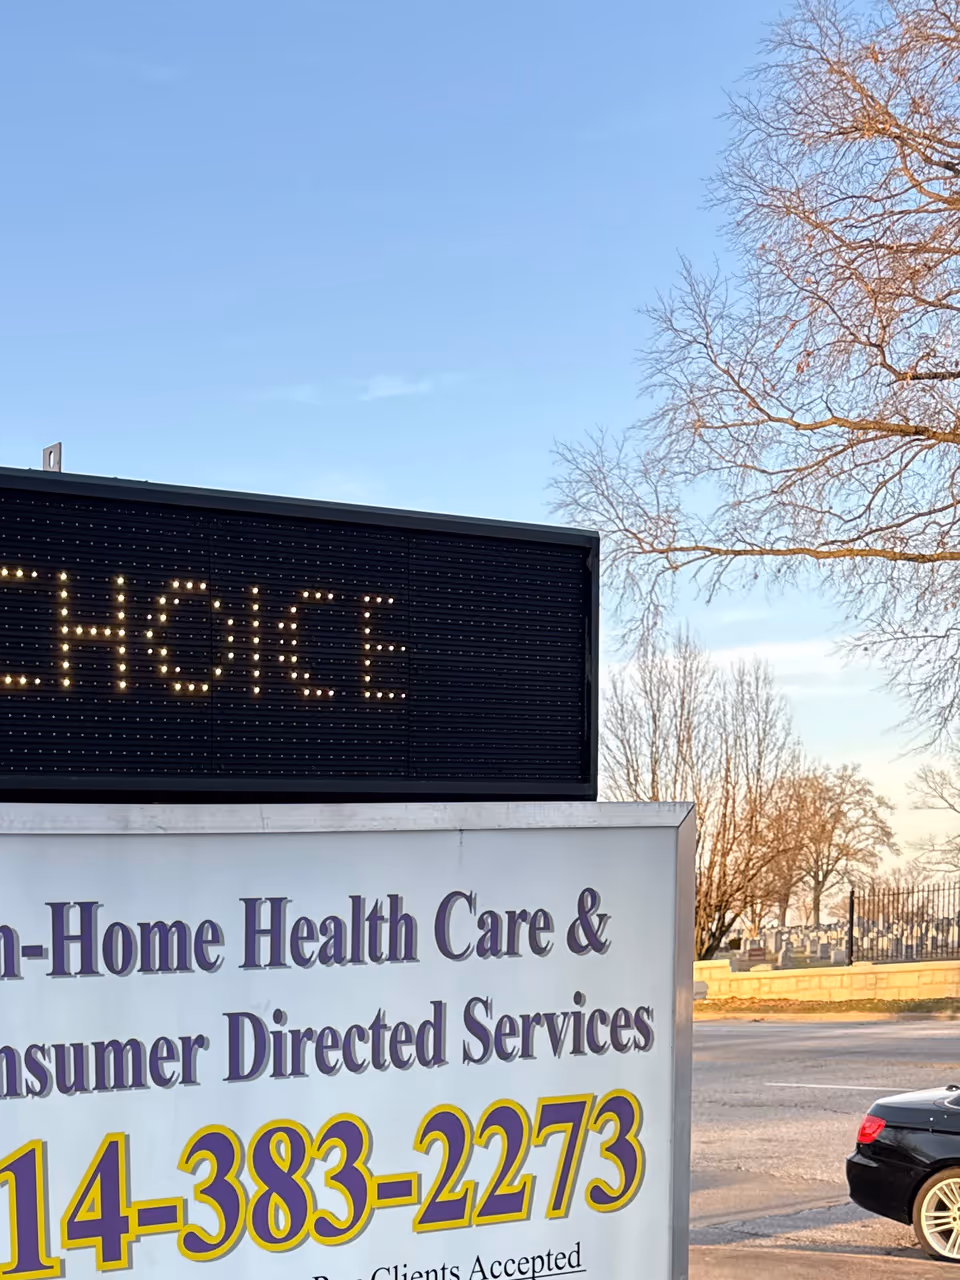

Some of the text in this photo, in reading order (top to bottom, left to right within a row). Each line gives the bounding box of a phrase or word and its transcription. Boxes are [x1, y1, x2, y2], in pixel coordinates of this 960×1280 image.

[239, 894, 419, 969] Health
[435, 891, 553, 962] Care
[567, 887, 611, 955] &
[223, 1000, 446, 1083] Directed
[462, 991, 655, 1064] Services
